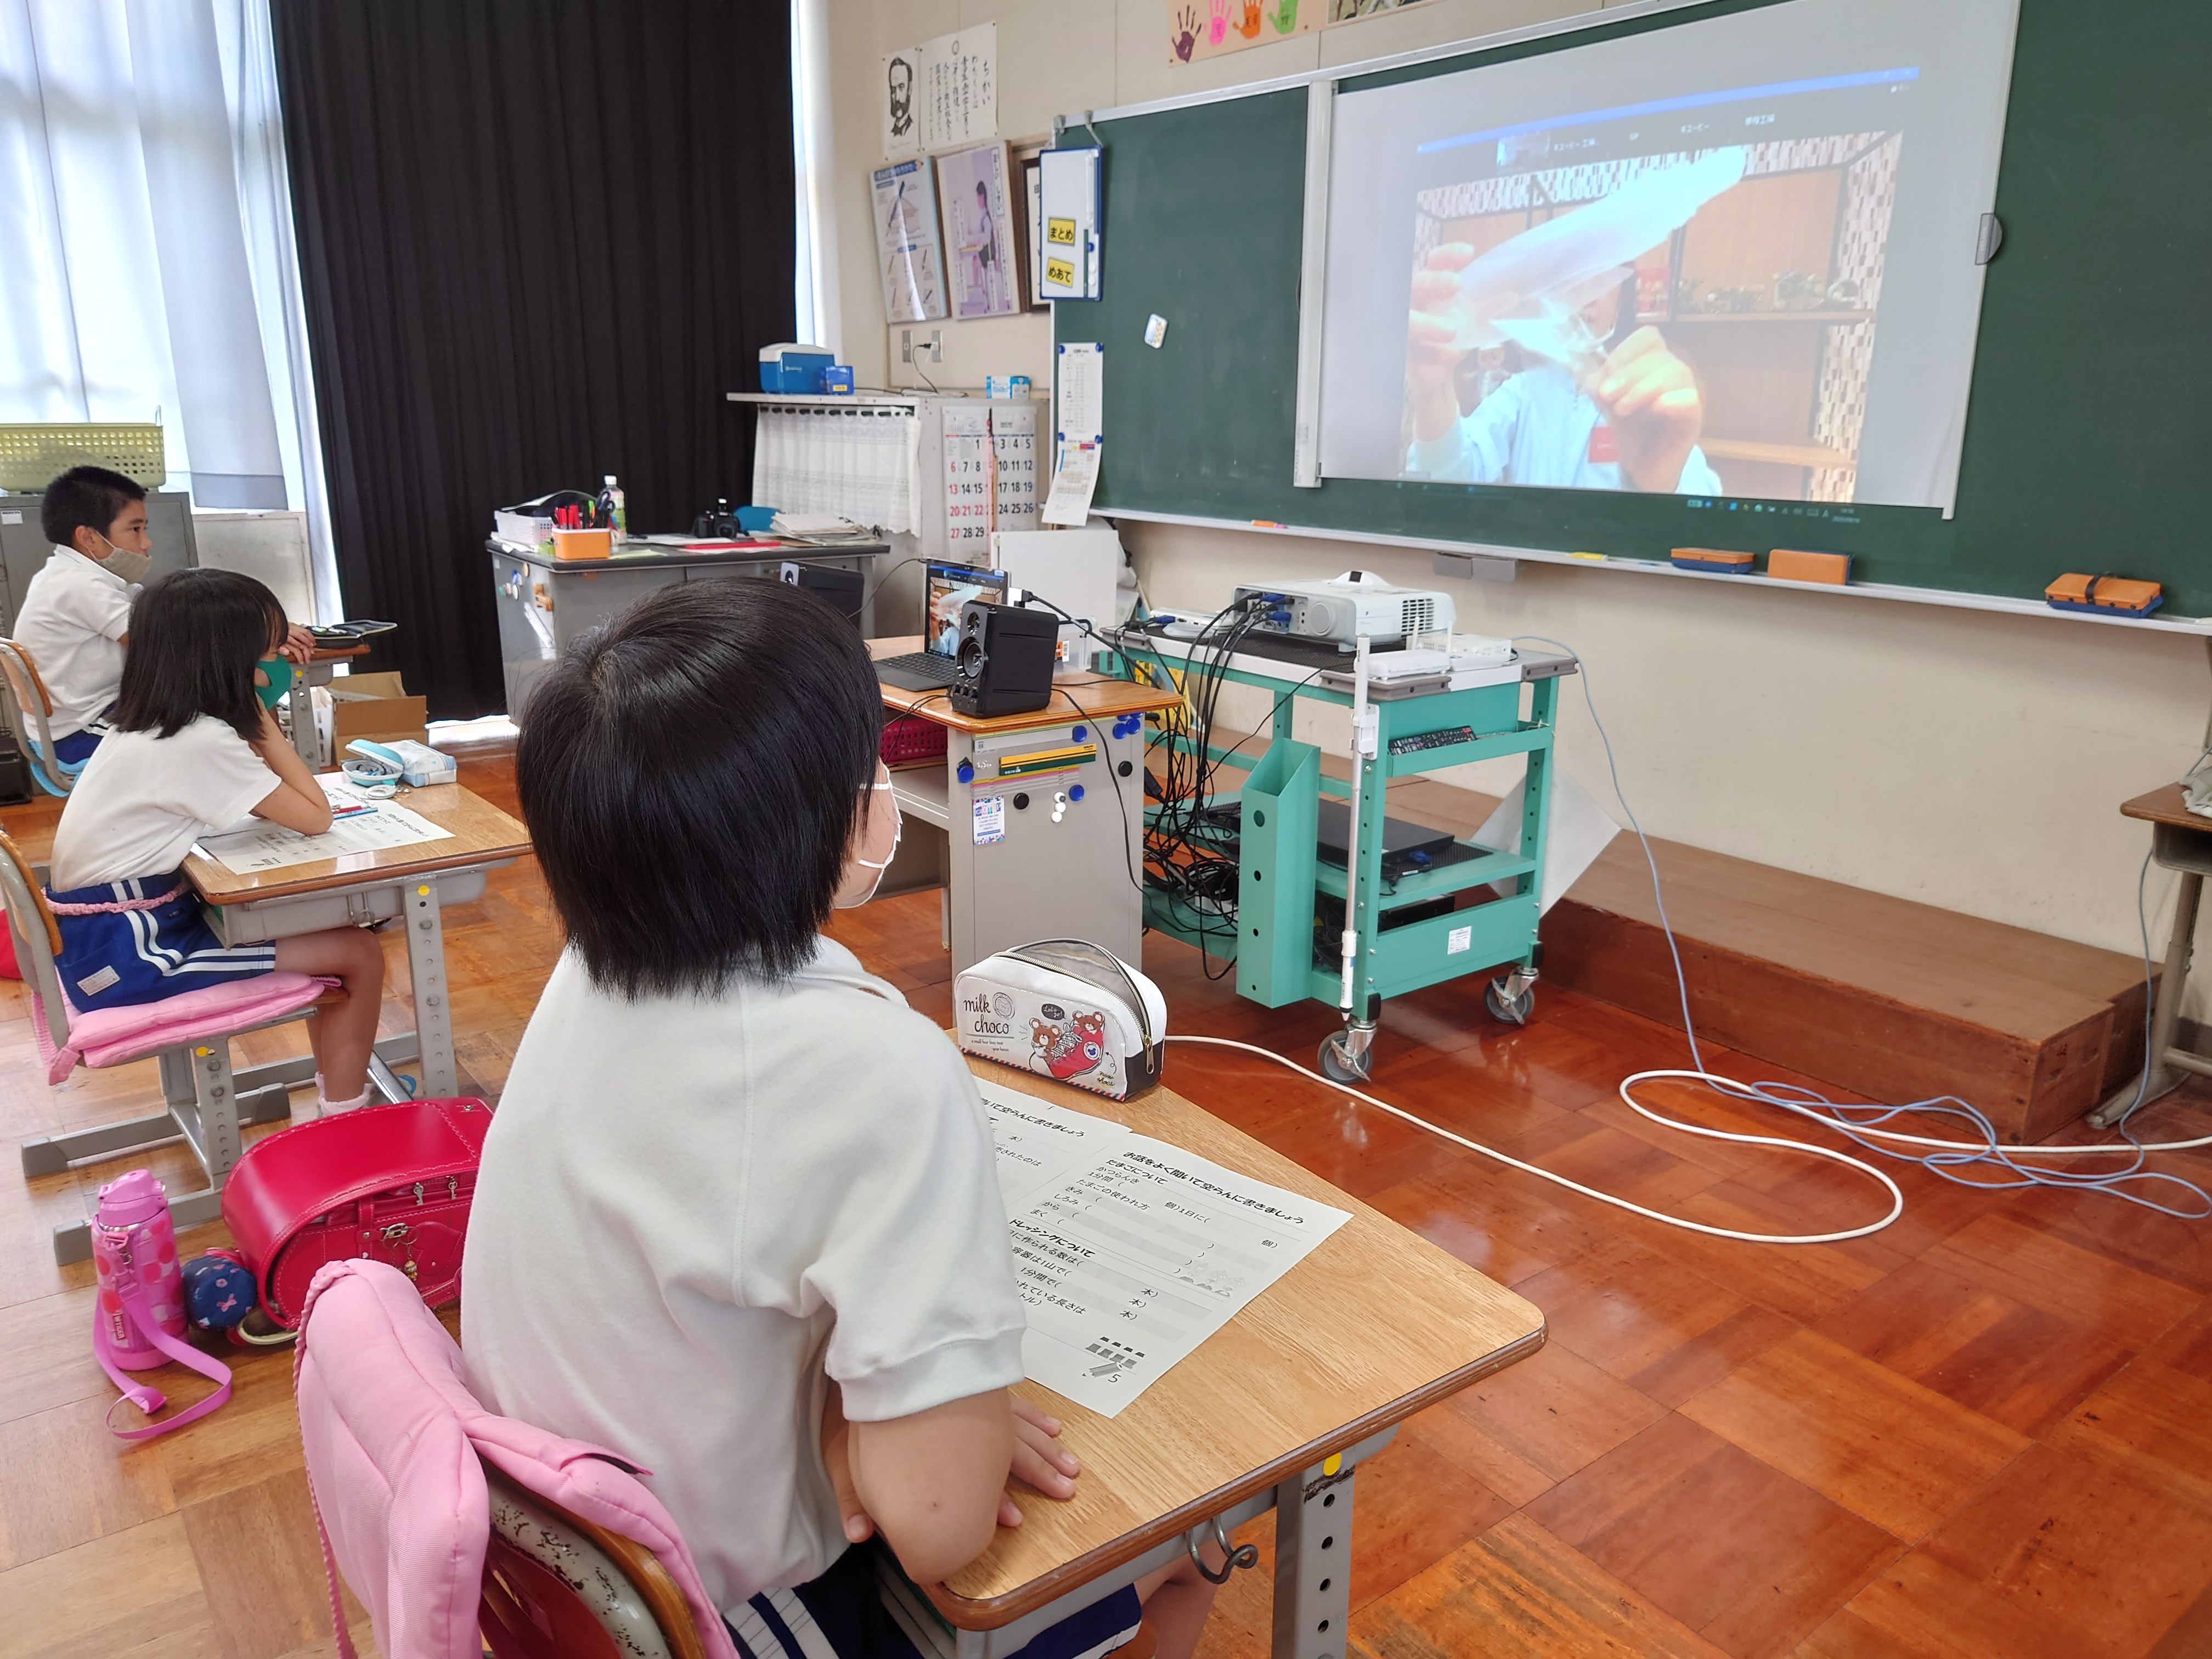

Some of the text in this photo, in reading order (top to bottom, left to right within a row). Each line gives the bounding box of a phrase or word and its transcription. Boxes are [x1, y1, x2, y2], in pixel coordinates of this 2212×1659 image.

[1050, 228, 1074, 241] まとめ
[1048, 267, 1072, 283] めあて
[976, 439, 1030, 450] 1 3 4 5
[950, 460, 1032, 472] 6 7 8 10 11 12
[949, 482, 1032, 494] 13 14 15 17 18 19
[950, 506, 959, 517] 20
[962, 505, 971, 516] 21
[974, 505, 983, 515] 22
[998, 504, 1008, 514] 24
[1011, 503, 1020, 514] 25
[1024, 503, 1034, 513] 26
[951, 527, 984, 539] 27 28 29
[963, 994, 991, 1013] milk
[974, 1014, 1009, 1034] choco
[1097, 1077, 1115, 1086] shoes
[1099, 1071, 1114, 1079] new
[994, 1146, 1042, 1166] 売されたのは
[1096, 1166, 1140, 1184] かつらんき
[1105, 1159, 1169, 1185] たまごについて
[1065, 1186, 1084, 1195] きみ
[1076, 1179, 1150, 1210] たまごの使われ方
[1122, 1152, 1304, 1224] お話をよく聞いて空らんに書きましょう
[1042, 1201, 1060, 1210] から
[1054, 1193, 1079, 1205] しろみ
[1030, 1209, 1048, 1217] まく
[1009, 1219, 1096, 1257] ドレッシングについて
[115, 1322, 125, 1339] TIGER
[1108, 1374, 1121, 1383] 5
